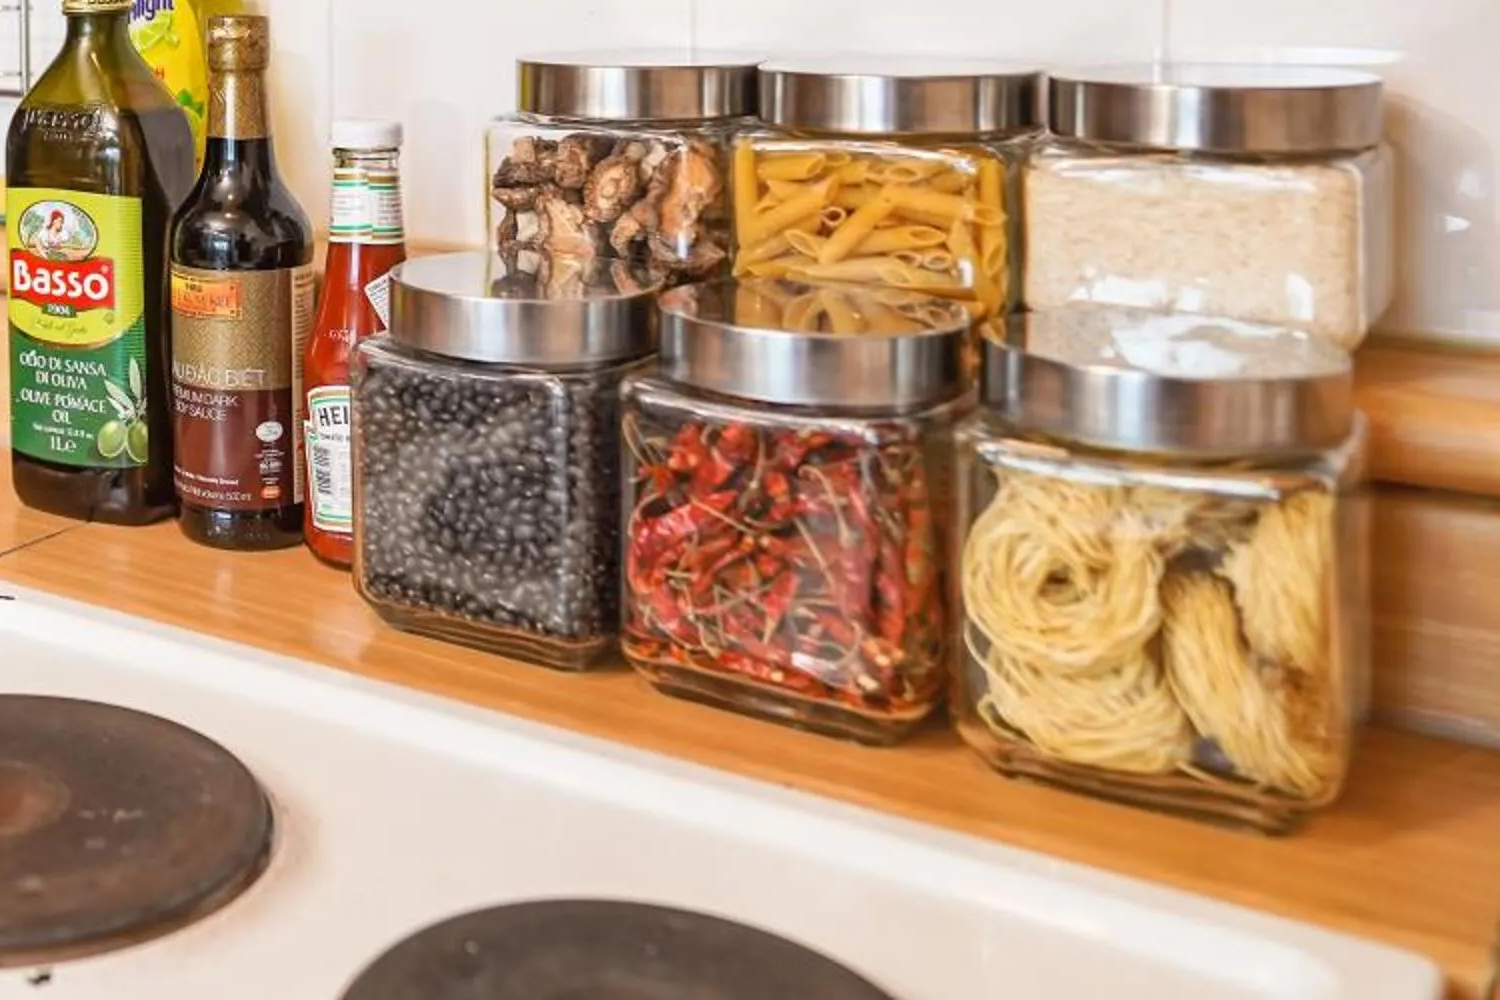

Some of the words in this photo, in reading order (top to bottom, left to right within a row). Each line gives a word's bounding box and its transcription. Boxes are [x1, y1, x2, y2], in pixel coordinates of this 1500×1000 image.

[13, 259, 109, 300] Basso
[49, 356, 62, 371] DI
[64, 359, 107, 377] SANSA
[35, 370, 49, 385] DI
[51, 373, 87, 390] OLIVA
[20, 388, 52, 406] OLIVE
[54, 394, 108, 414] POMACE
[51, 409, 72, 425] OIL
[318, 405, 349, 427] HEI
